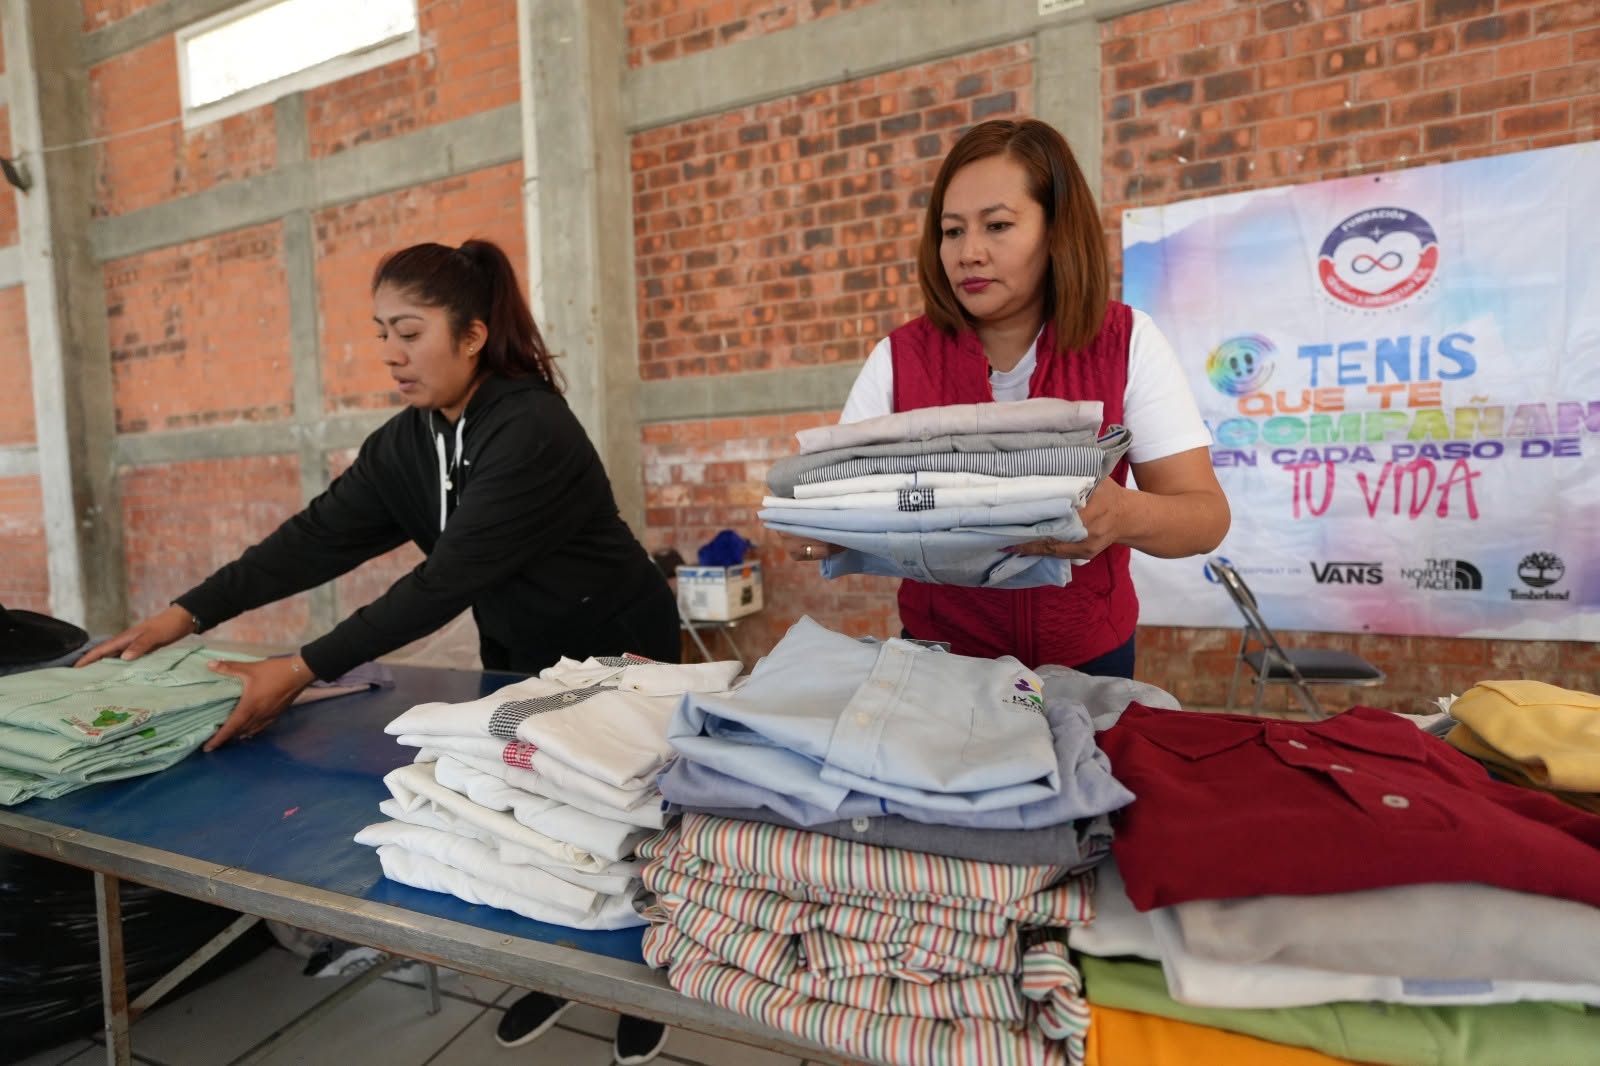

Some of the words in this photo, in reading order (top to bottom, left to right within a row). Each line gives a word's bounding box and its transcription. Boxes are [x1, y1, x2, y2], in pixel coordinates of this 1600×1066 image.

[1340, 209, 1408, 233] FUNDACIÓN
[1298, 332, 1477, 388] TENIS
[1237, 387, 1348, 417] QUE
[1367, 382, 1443, 412] TE
[1203, 396, 1600, 448] COMPAÑAN
[1212, 450, 1257, 467] EN
[1271, 444, 1375, 465] CADA
[1392, 440, 1504, 463] PASO
[1520, 438, 1582, 457] DE
[1283, 460, 1337, 520] TU
[1357, 458, 1481, 520] VIDA
[1310, 561, 1383, 585] VANS
[1400, 568, 1455, 582] NORTH
[1424, 559, 1455, 571] THE
[1415, 578, 1455, 591] FACE
[1508, 588, 1570, 602] Timberland
